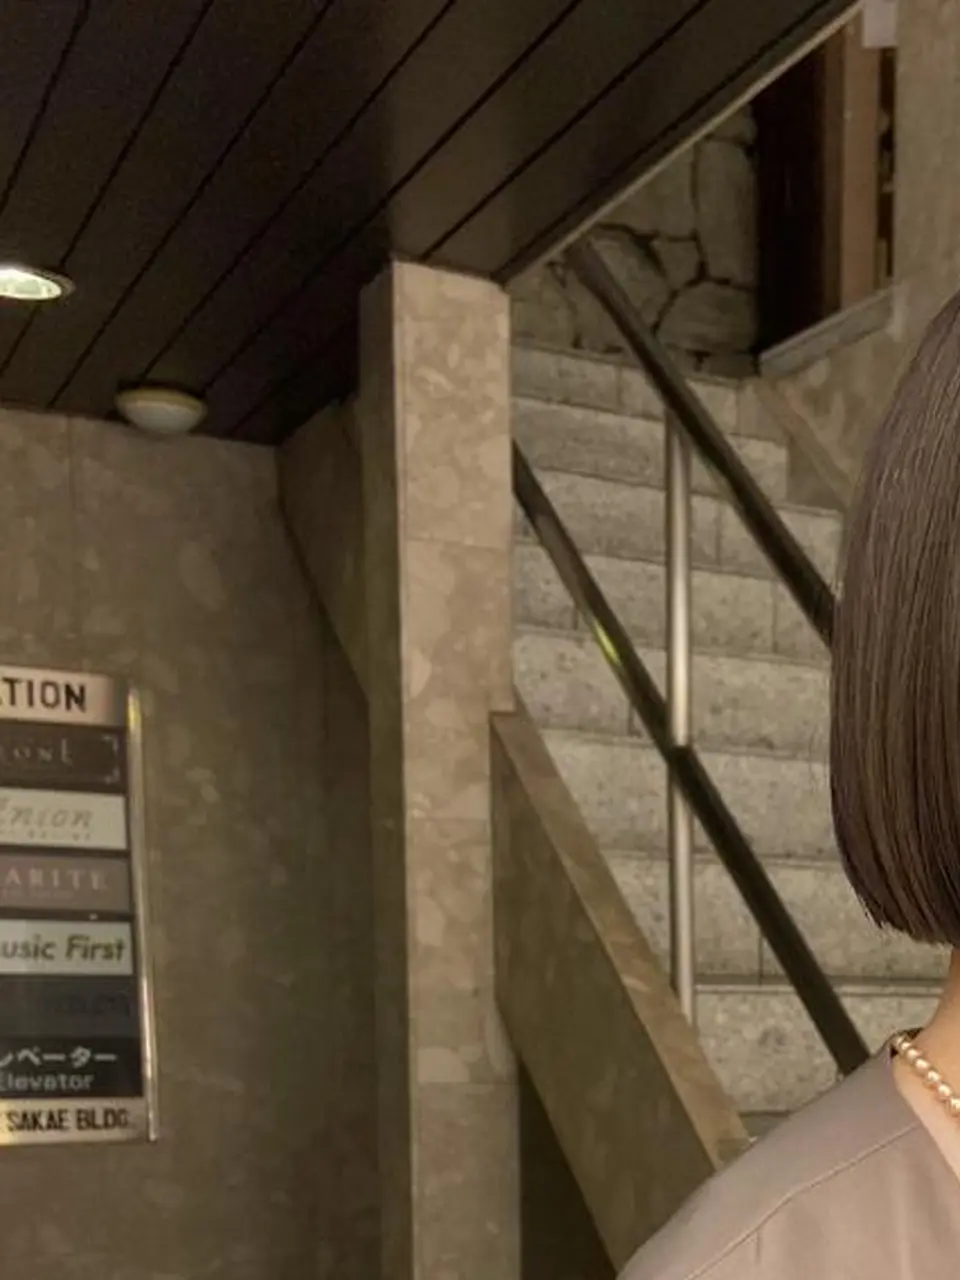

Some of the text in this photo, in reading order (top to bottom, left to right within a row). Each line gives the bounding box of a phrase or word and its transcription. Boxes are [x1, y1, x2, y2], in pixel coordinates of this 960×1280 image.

[0, 677, 86, 713] TION
[65, 934, 125, 962] First
[7, 1108, 71, 1132] SAKAE
